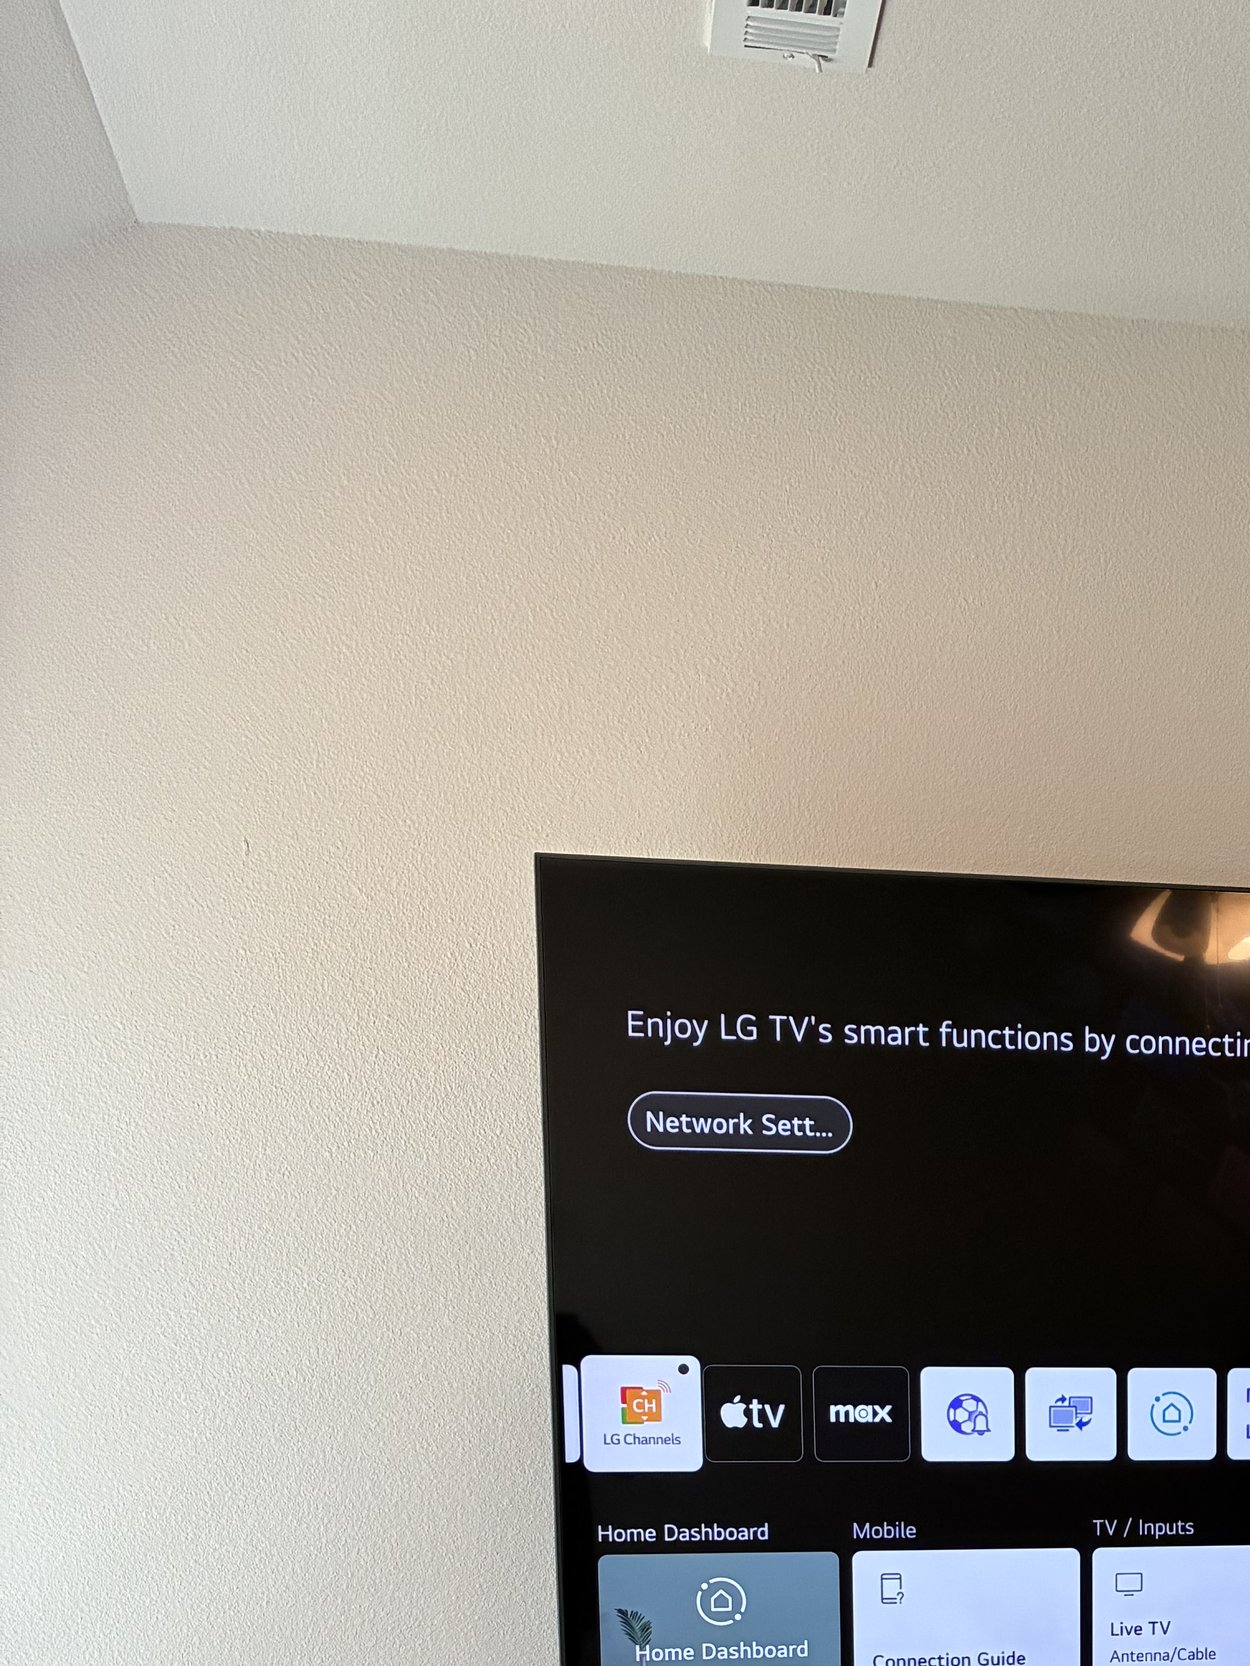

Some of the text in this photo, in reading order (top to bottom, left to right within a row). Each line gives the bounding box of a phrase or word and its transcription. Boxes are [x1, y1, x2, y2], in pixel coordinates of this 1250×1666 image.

[627, 1010, 709, 1047] Enjoy
[720, 1013, 758, 1041] LG
[768, 1015, 833, 1044] TV's
[844, 1023, 930, 1047] smart
[939, 1020, 1074, 1052] functions
[1084, 1025, 1116, 1060] by
[646, 1110, 754, 1135] Network
[632, 1397, 657, 1414] CH
[748, 1398, 786, 1428] tv
[829, 1404, 893, 1423] max
[603, 1432, 682, 1446] LG Channels
[598, 1522, 769, 1542] Home Dashboard
[853, 1521, 917, 1539] Mobile
[1092, 1517, 1195, 1540] TV / Inputs
[1110, 1620, 1172, 1637] Live TV
[635, 1639, 809, 1662] Home Dashboard
[977, 1650, 1026, 1666] Guide
[1109, 1646, 1217, 1664] Antenna/Cable
